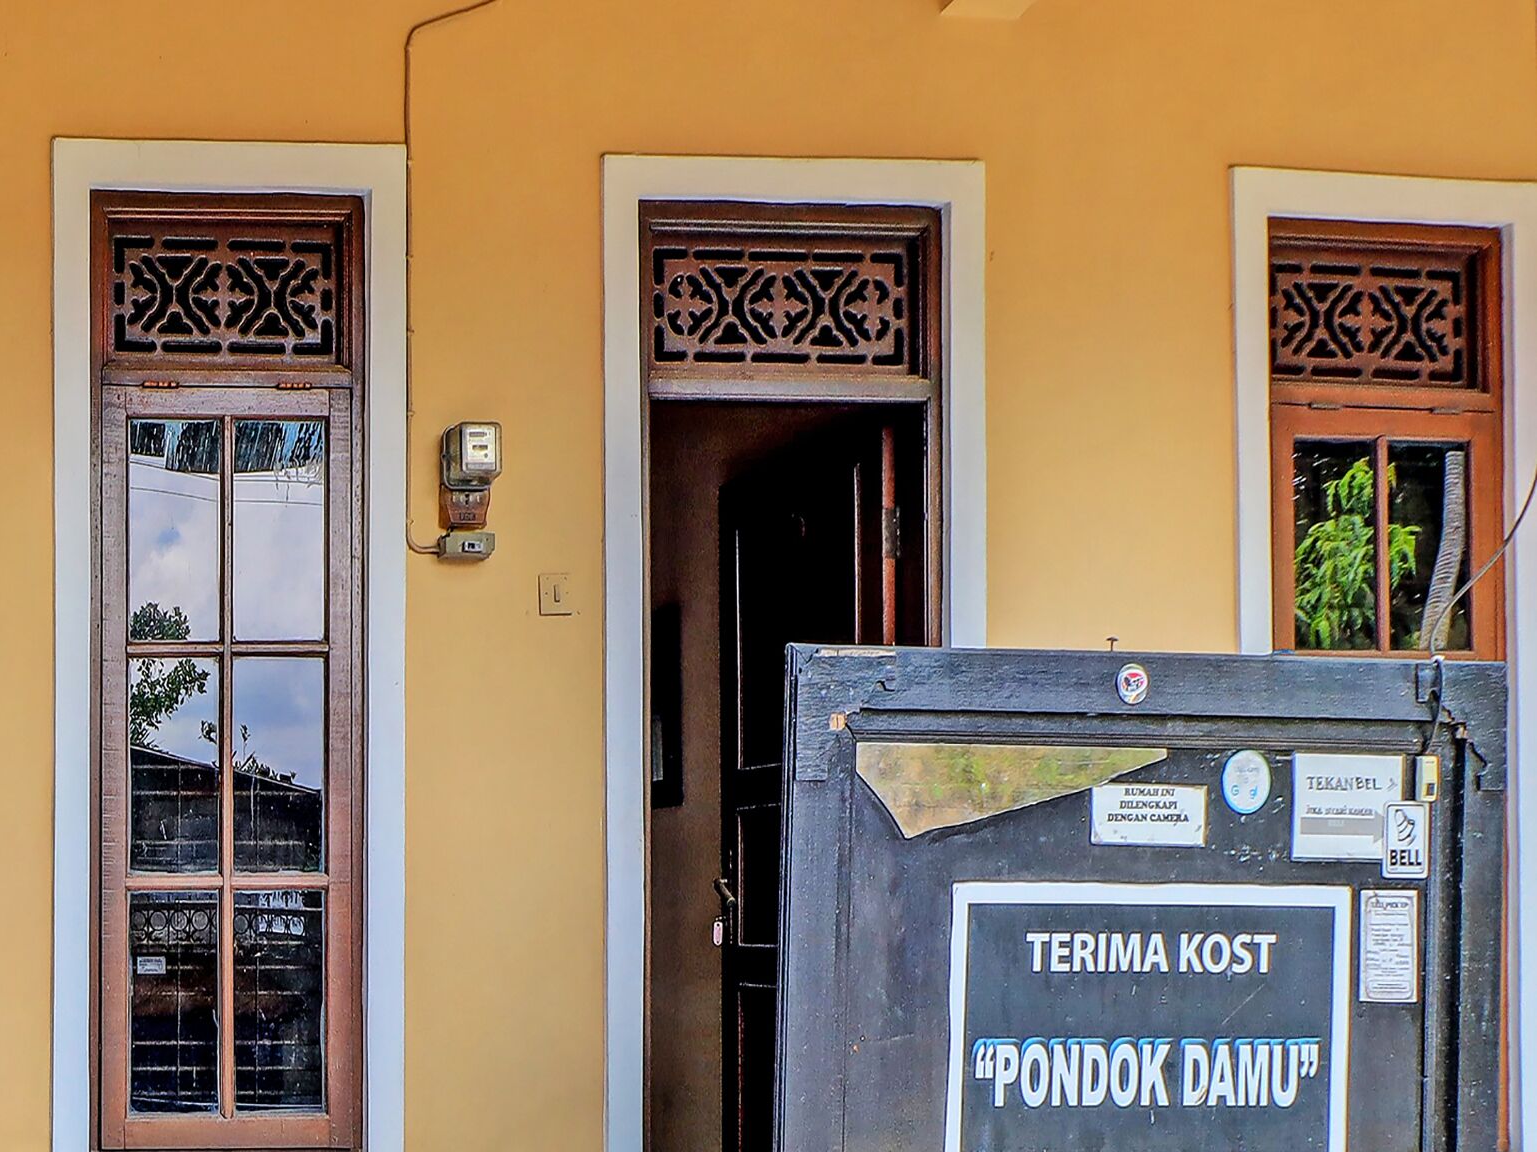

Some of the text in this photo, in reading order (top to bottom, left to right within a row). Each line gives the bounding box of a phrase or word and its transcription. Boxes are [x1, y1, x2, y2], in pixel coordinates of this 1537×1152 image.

[1306, 776, 1354, 791] TEKAN
[1124, 788, 1175, 797] RUMAH INI
[1119, 801, 1178, 809] DILENGKAPI
[1107, 813, 1190, 822] DENGAN CAMERA
[1389, 849, 1423, 866] BELL
[1026, 932, 1278, 975] TERIMA KOST
[973, 1037, 1321, 1108] “PONDOK DAMU”
